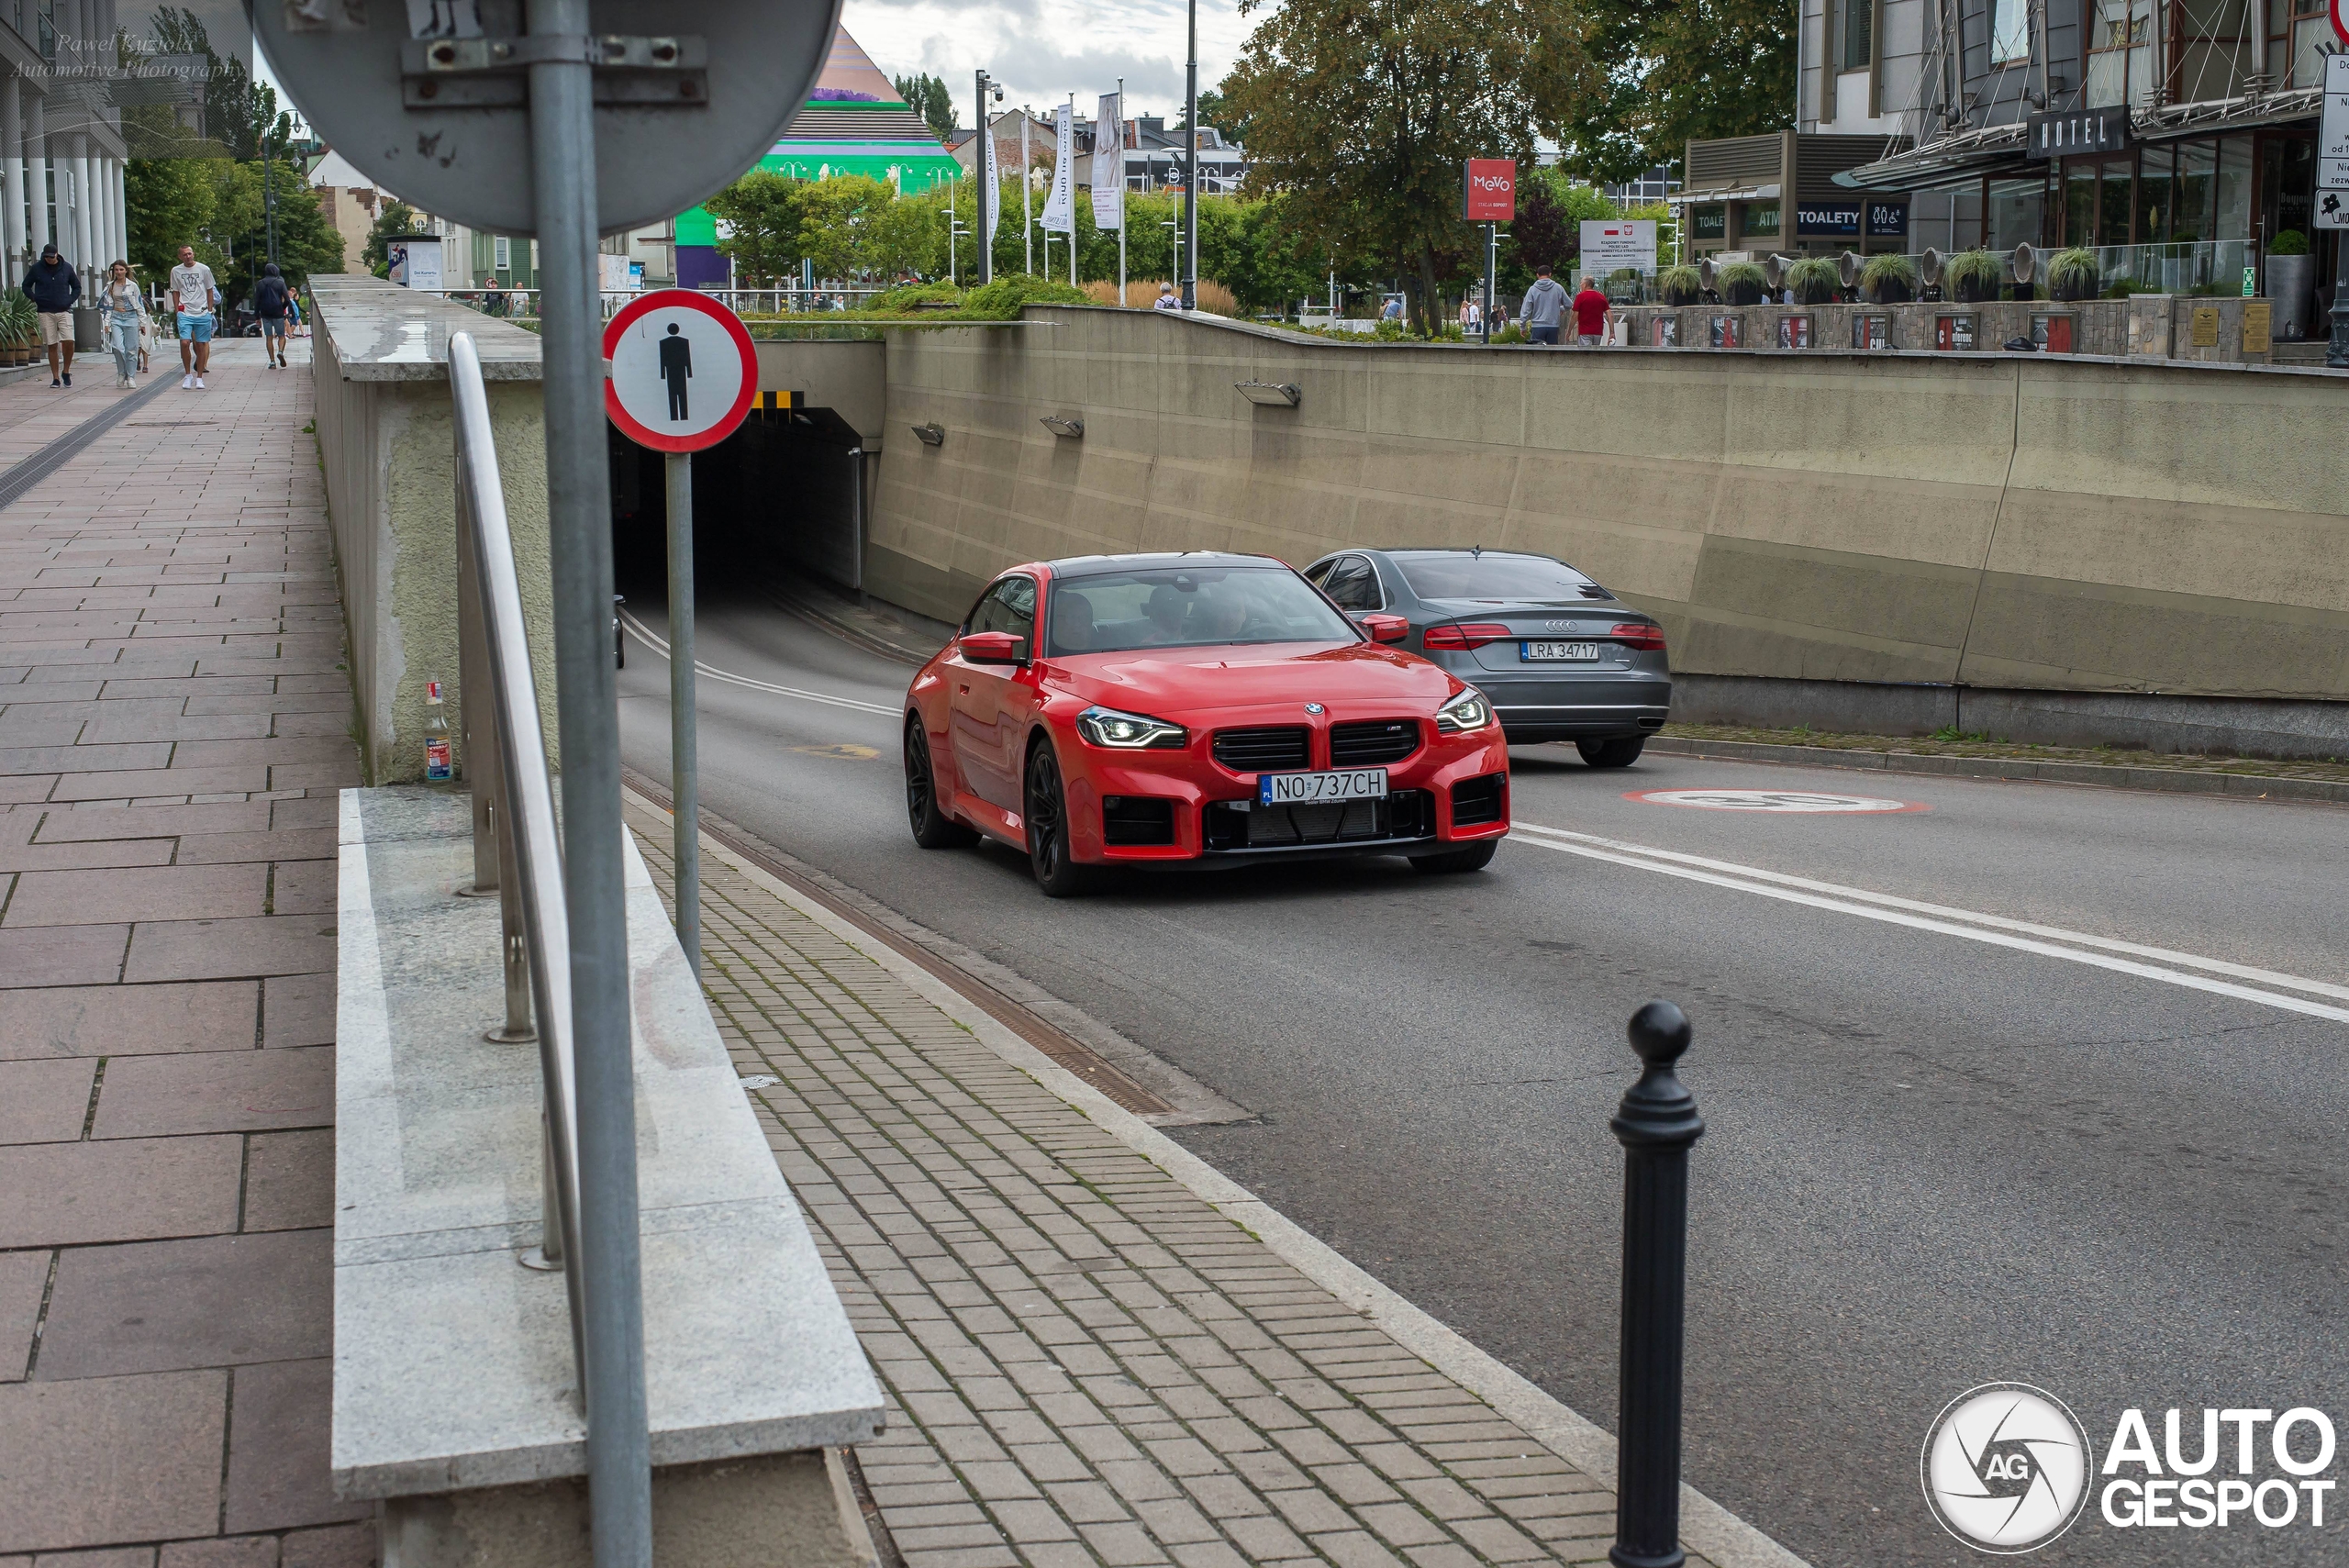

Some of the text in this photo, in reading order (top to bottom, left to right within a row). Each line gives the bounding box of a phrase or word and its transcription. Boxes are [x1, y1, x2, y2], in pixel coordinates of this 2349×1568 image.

[2042, 116, 2107, 149] HOTEL
[2332, 145, 2343, 153] od
[1759, 210, 1780, 227] ATM
[1798, 211, 1860, 224] TOALETY
[1529, 644, 1554, 658] LRA
[1558, 644, 1596, 658] 34717
[1276, 776, 1305, 799] NO
[1313, 772, 1381, 797] 737CH
